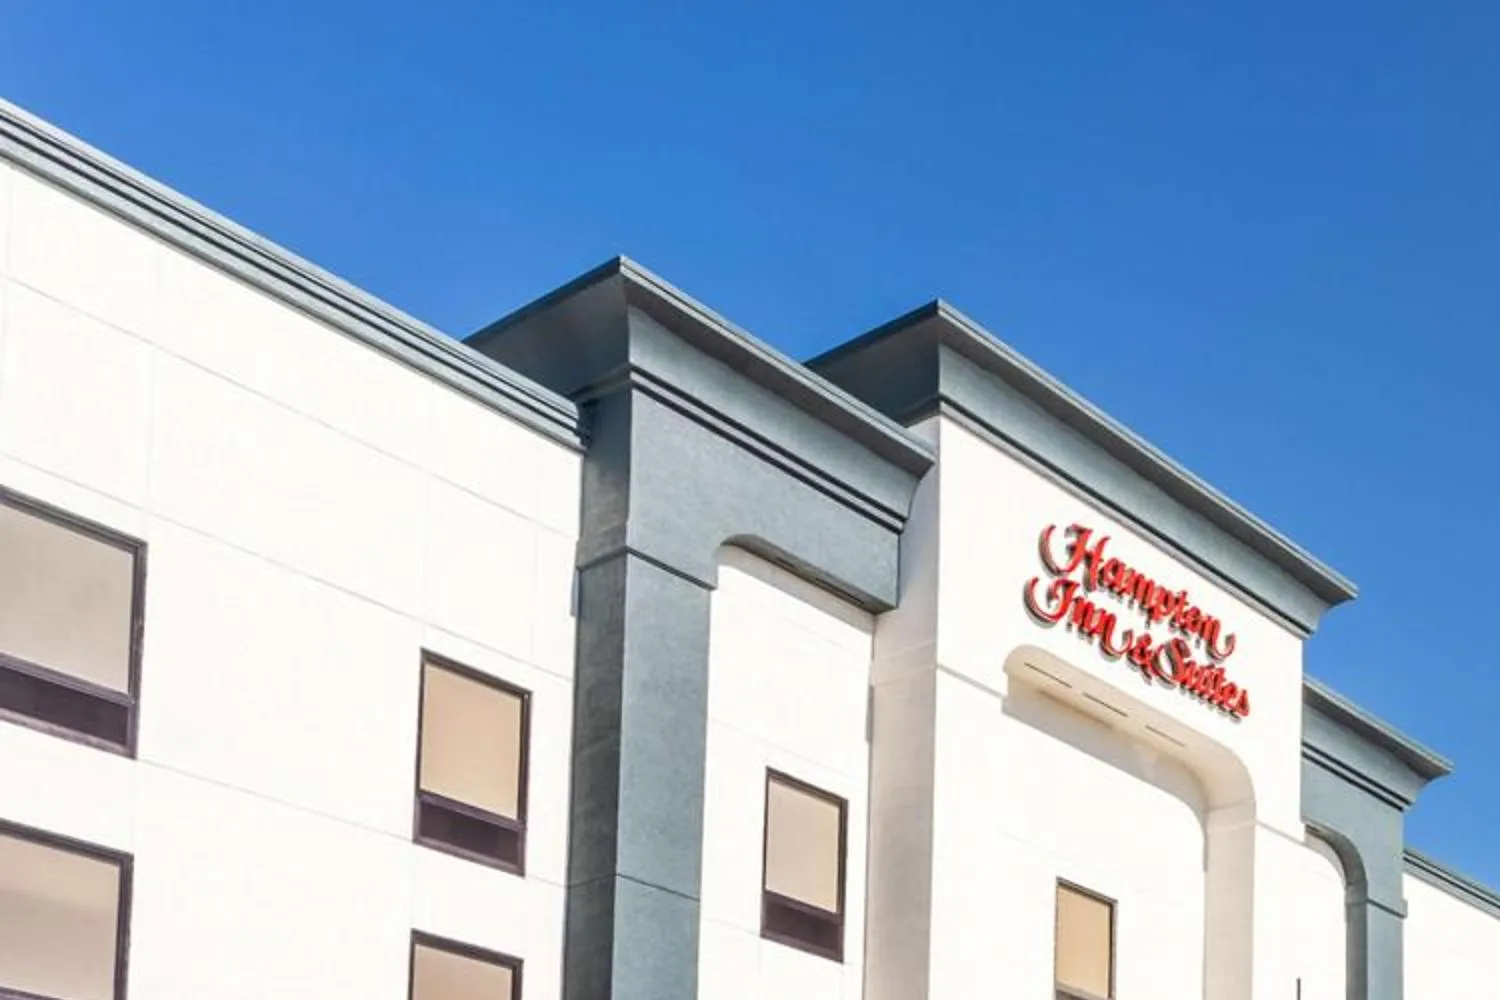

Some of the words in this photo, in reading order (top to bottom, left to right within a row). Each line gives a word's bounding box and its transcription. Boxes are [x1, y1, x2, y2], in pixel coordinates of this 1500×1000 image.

[1024, 577, 1133, 660] Inn
[1151, 637, 1250, 722] Suites
[1038, 524, 1236, 662] Hampton
